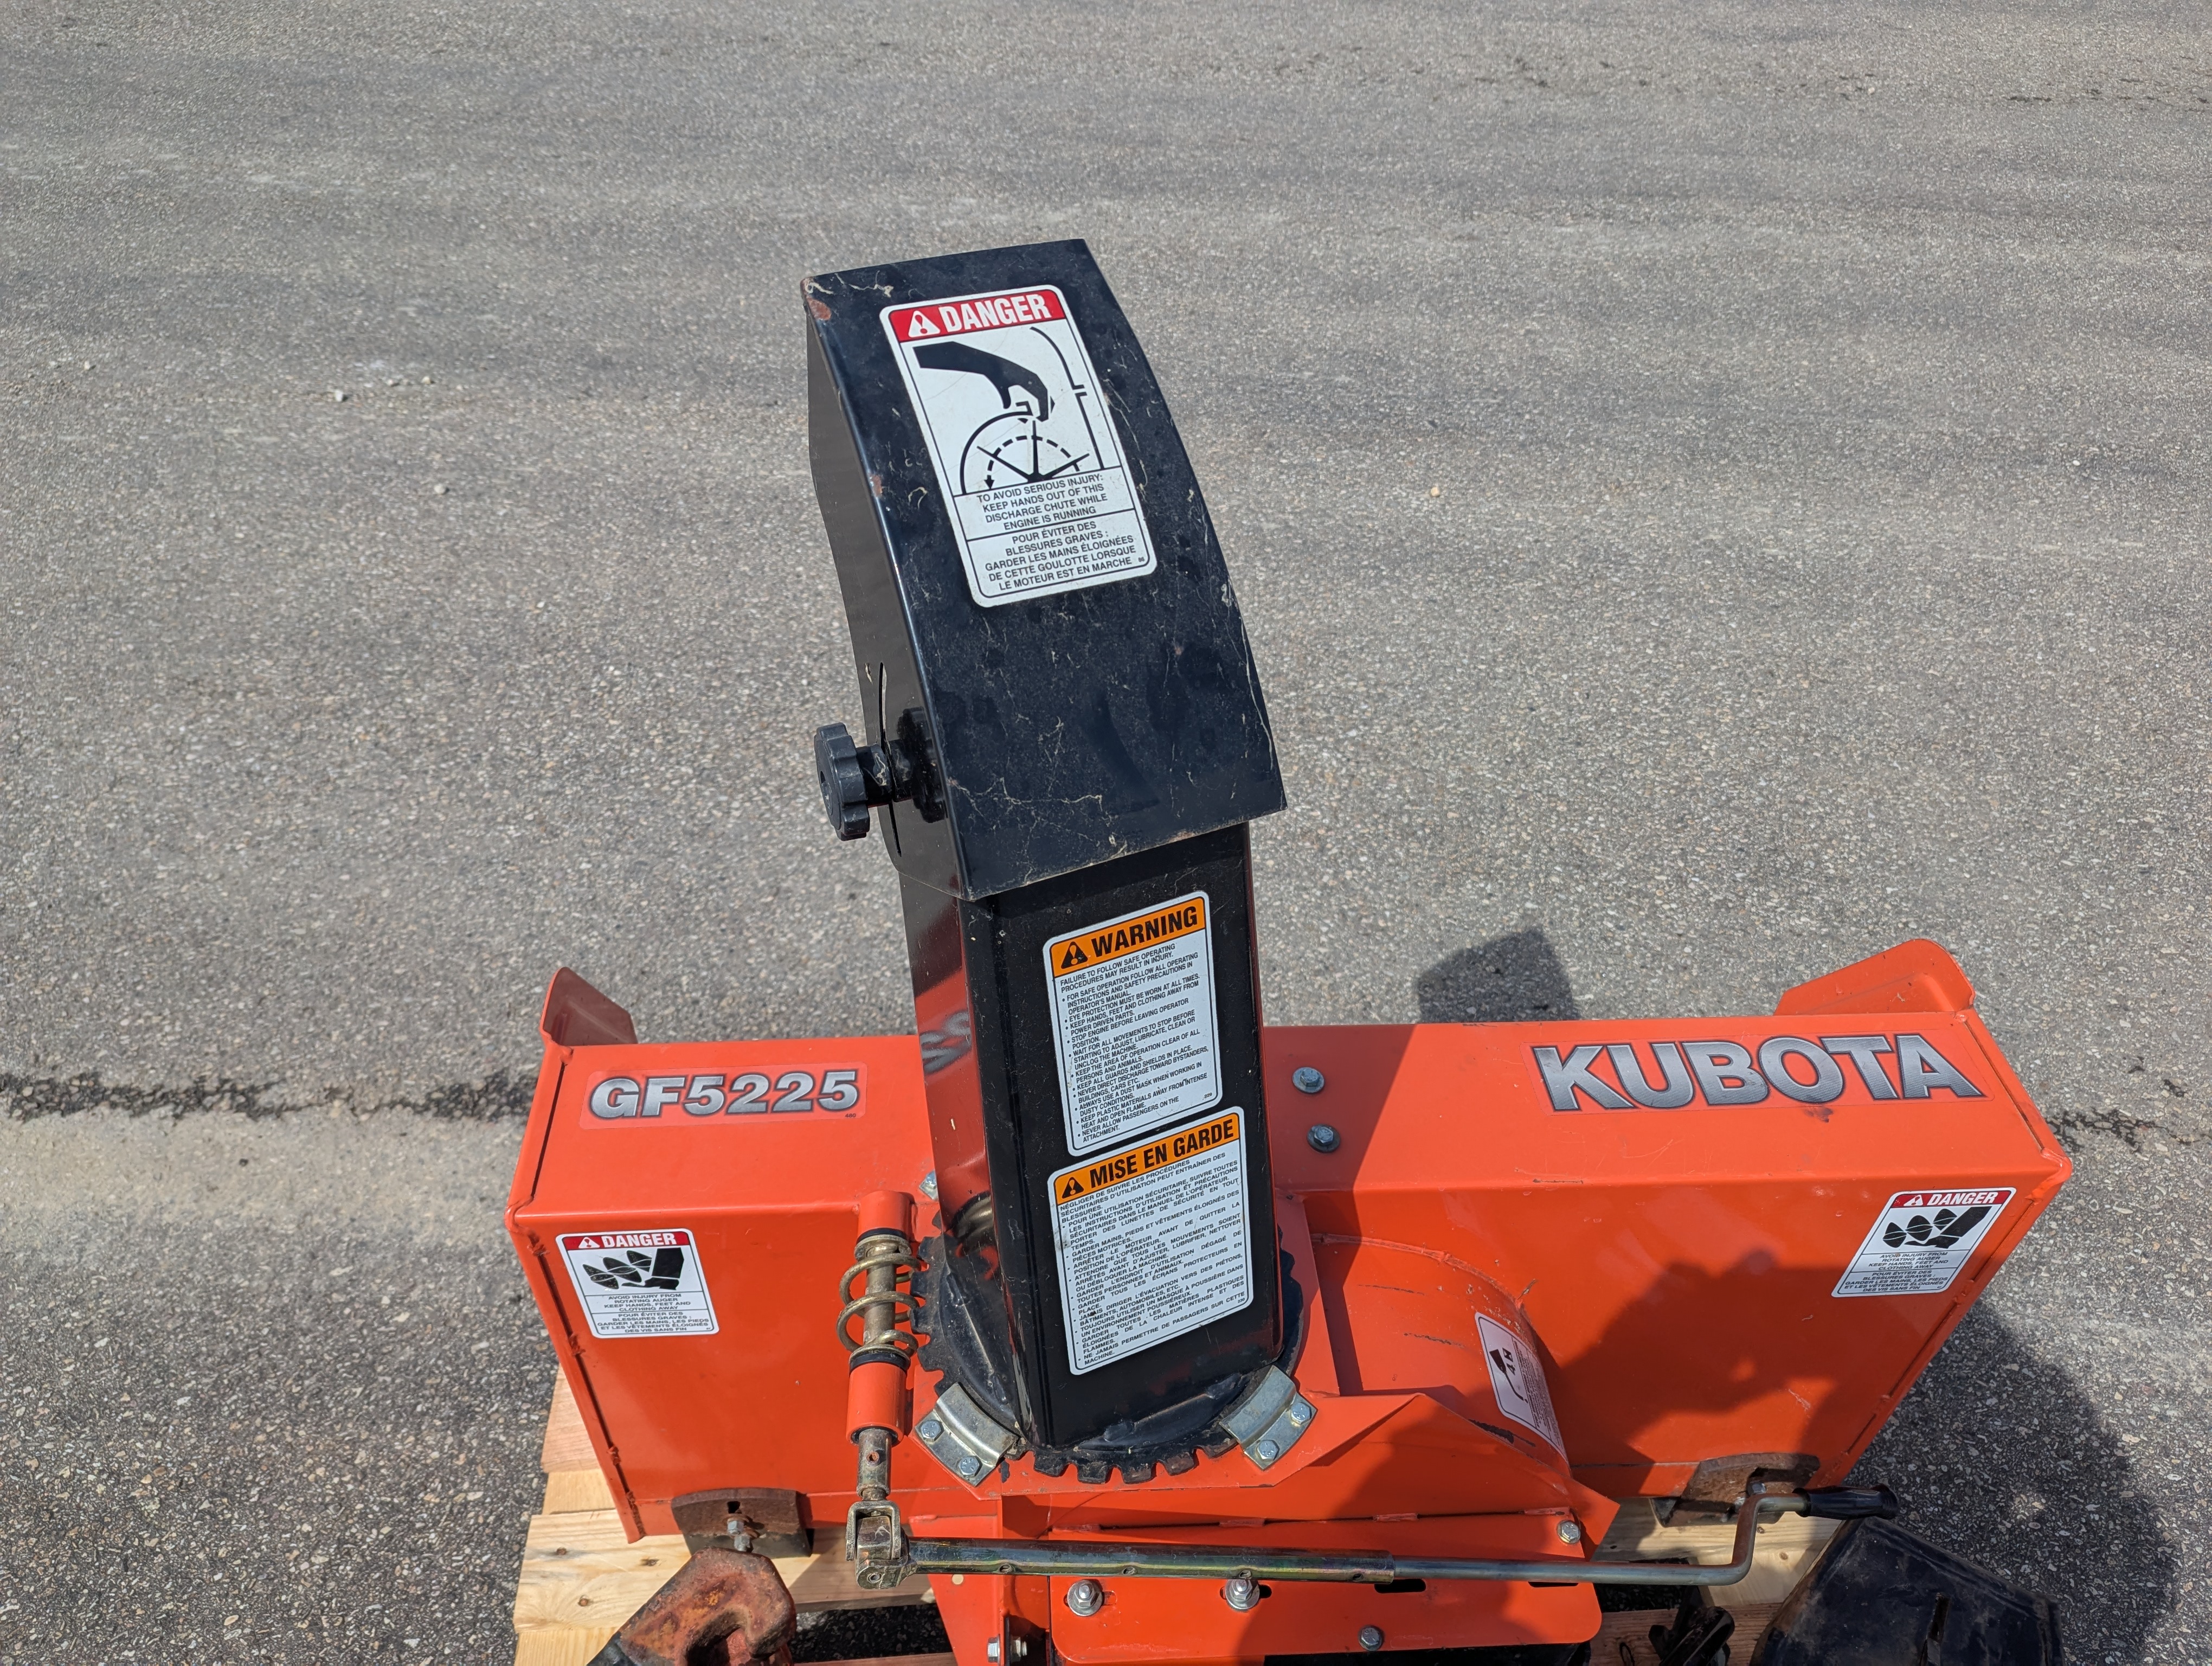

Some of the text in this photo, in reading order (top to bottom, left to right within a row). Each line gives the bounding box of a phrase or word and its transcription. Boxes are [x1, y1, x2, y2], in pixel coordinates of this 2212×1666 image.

[938, 293, 1052, 332] DANGER
[976, 473, 1103, 503] TO AVOID SERIOUS INJURY:
[982, 483, 1104, 512] KEEP HANDS OUT OF THIS
[985, 493, 1108, 523] DISCHARGE CHUTE WHILE
[1003, 505, 1096, 530] ENGINE IS RUNNING
[1012, 521, 1096, 544] POUR ÉVITER DES
[985, 535, 1134, 571] GARDER LES MAINS ÉLOIGNÉES
[988, 544, 1136, 581] DE CETTE GOULOTTE LORSQUE
[1005, 530, 1103, 556] BLESSURES GRAVES
[999, 556, 1132, 591] LE MOTEUR EST EN MARCHE
[1091, 906, 1198, 957] WARNING
[1060, 972, 1086, 986] FAILURE
[1097, 960, 1122, 975] FOLLOW
[1123, 954, 1140, 965] SAFE
[1141, 943, 1175, 959] OPERATING
[1061, 974, 1104, 993] PROCEDURES
[1104, 969, 1117, 979] MAY
[1119, 961, 1142, 975] RESULT
[1151, 951, 1173, 964] INJURY.
[1066, 952, 1198, 1001] FOR SAFE OPERATION FOLLOW ALL OPERATING
[1067, 989, 1110, 1008] INSTRUCTIONS
[1111, 985, 1123, 994] AND
[1124, 976, 1146, 990] SAFETY
[1147, 963, 1186, 982] PRECAUTIONS
[1068, 990, 1131, 1015] OPERATOR'S MANUAL.
[1069, 973, 1200, 1022] EYE PROTECTION MUST BE WORN AT ALL TIMES.
[1532, 1033, 1989, 1111] KUBOTA
[590, 1069, 859, 1120] GF5225
[1082, 1095, 1179, 1136] NEVER ALLOW PASSENGERS ON THE
[1083, 1124, 1120, 1143] ATTACHMENT.
[1090, 1119, 1233, 1188] MISE EN GARDE
[1060, 1152, 1225, 1217] SÉCURITAIRES D'UTILISATION PEUT ENTRAÎNER DES
[1060, 1195, 1094, 1211] NÉGLIGER
[1106, 1181, 1130, 1194] SUIVRE
[1131, 1176, 1144, 1184] LES
[1146, 1159, 1190, 1180] PROCÉDURES
[1068, 1216, 1087, 1227] POUR
[1104, 1195, 1143, 1214] UTILISATION
[1145, 1179, 1188, 1199] SÉCURITAIRE,
[1189, 1169, 1212, 1182] SUIVRE
[1213, 1160, 1238, 1172] TOUTES
[1069, 1225, 1082, 1233] LES
[1085, 1206, 1133, 1227] INSTRUCTIONS
[1135, 1187, 1180, 1208] D'UTILISATION
[1194, 1166, 1238, 1186] PRÉCAUTIONS
[1927, 1192, 1998, 1205] DANGER
[1070, 1218, 1117, 1239] SÉCURITAIRES
[1118, 1210, 1136, 1221] DANS
[1147, 1196, 1174, 1210] MANUEL
[1186, 1176, 1229, 1196] L'OPÉRATEUR.
[601, 1233, 677, 1247] DANGER
